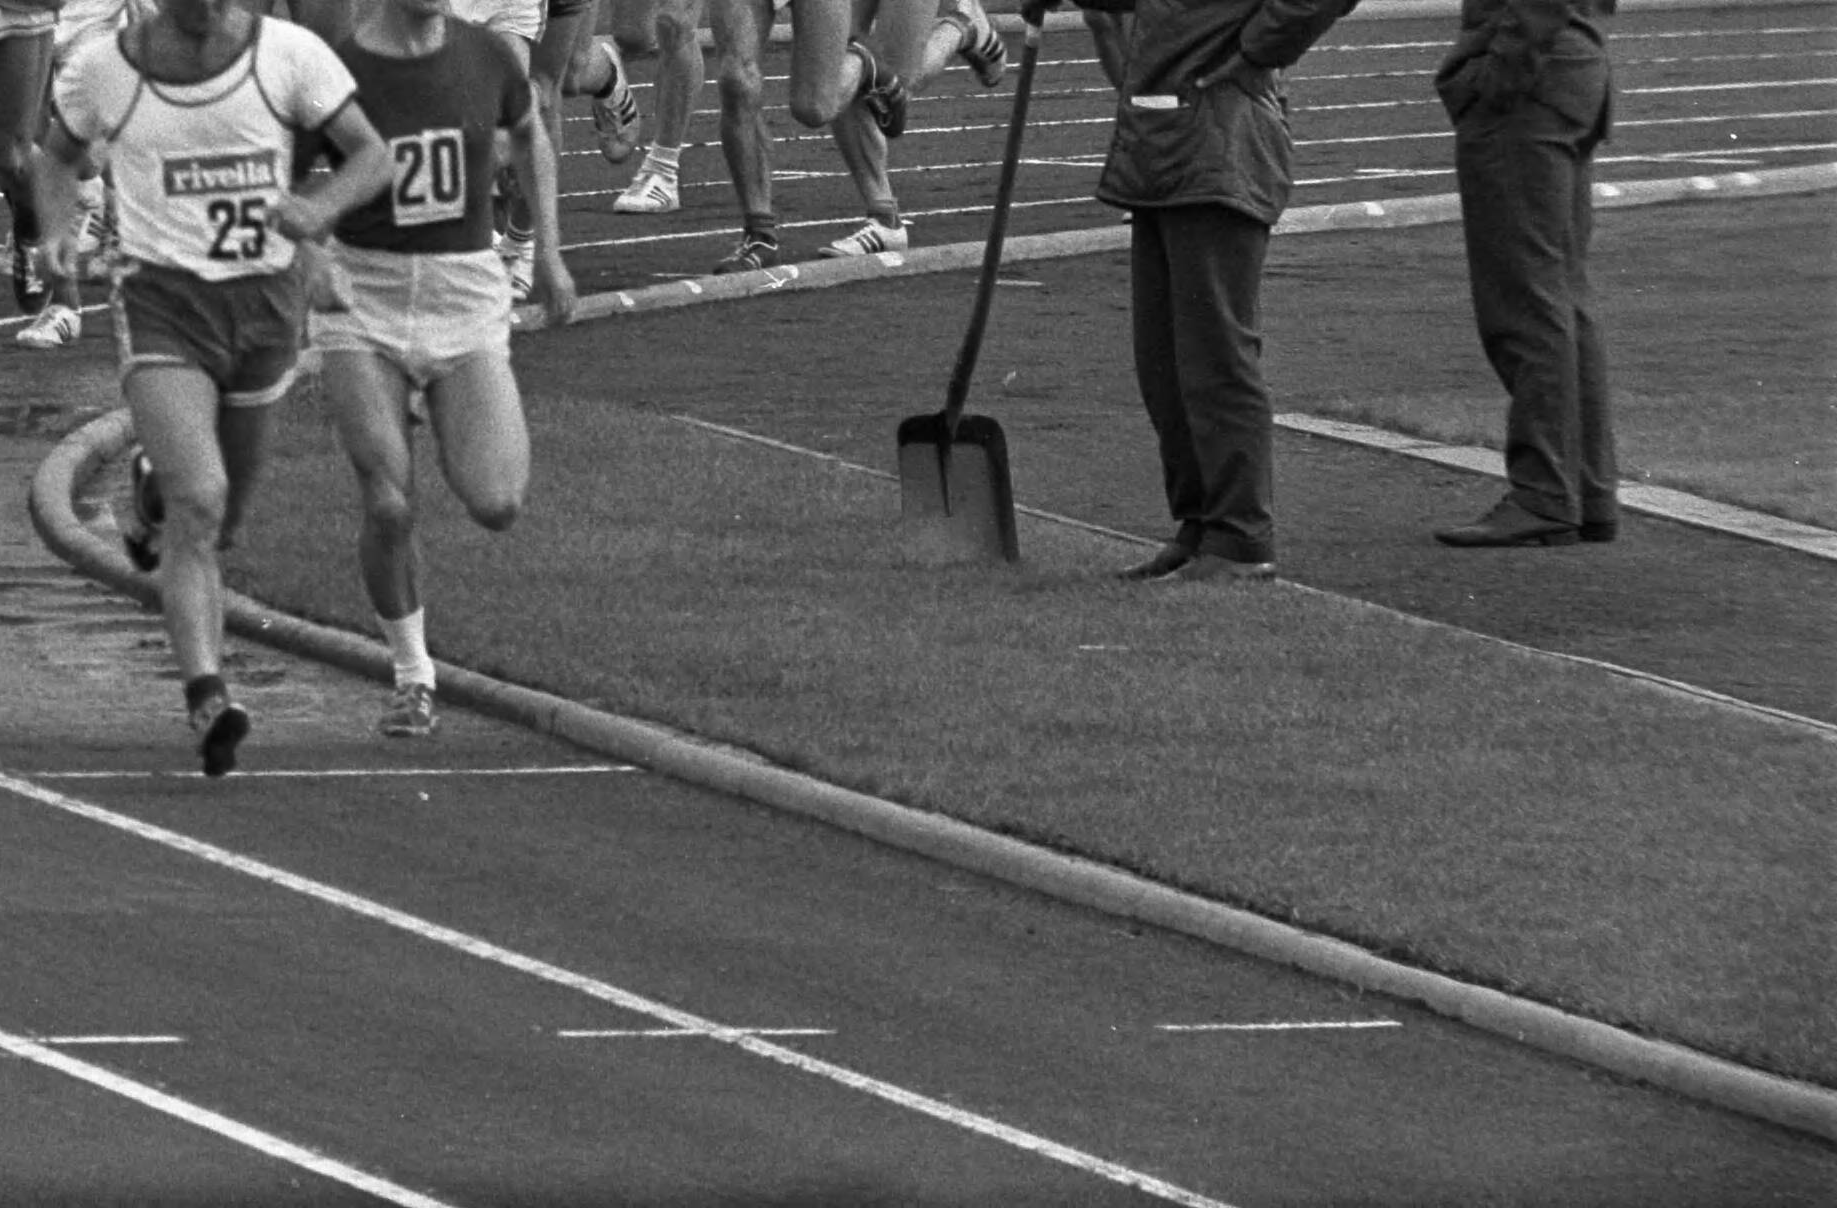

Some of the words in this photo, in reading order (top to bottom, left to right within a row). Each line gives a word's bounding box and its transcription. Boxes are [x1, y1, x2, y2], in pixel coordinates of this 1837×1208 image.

[172, 161, 272, 190] rivella
[394, 137, 461, 206] 20
[208, 197, 265, 260] 25
